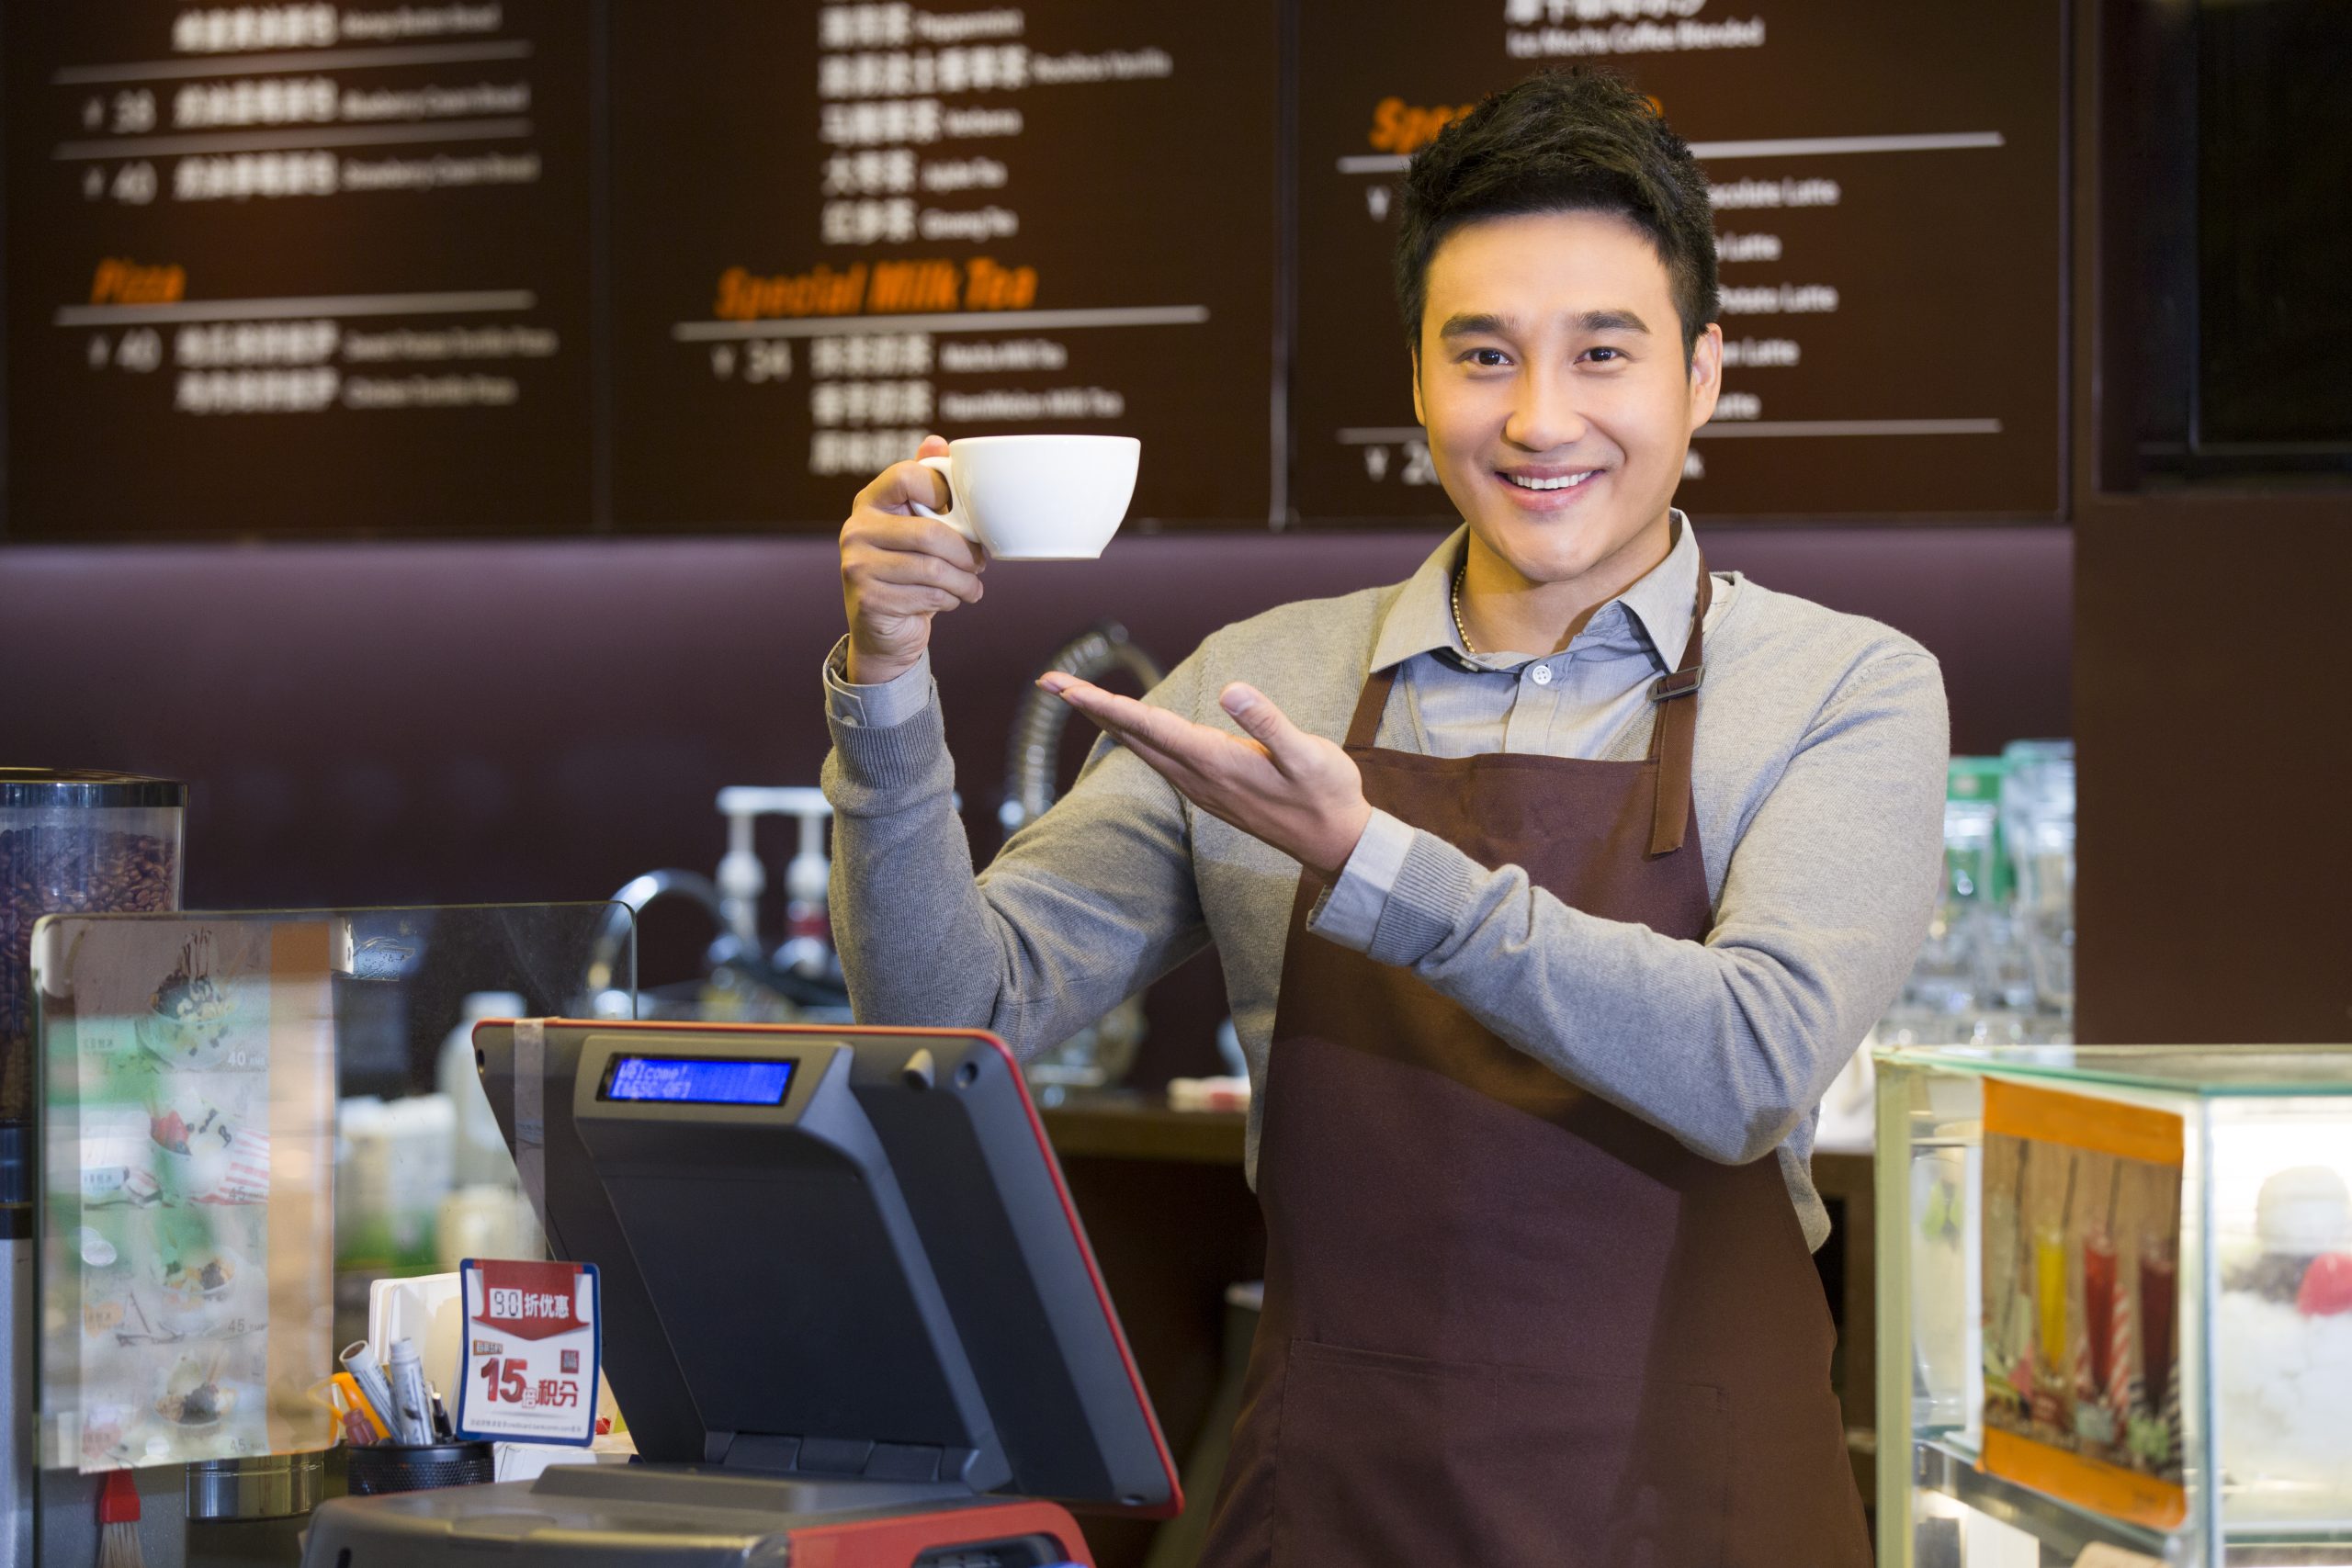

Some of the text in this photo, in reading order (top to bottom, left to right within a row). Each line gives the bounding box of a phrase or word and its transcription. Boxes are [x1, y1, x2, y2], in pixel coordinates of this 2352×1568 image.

[1610, 20, 1674, 53] Coffee
[1676, 14, 1765, 50] Blended
[1781, 175, 1840, 207] Latte
[1724, 231, 1782, 263] Latte
[715, 255, 1039, 324] Special Milk Tea
[1781, 282, 1839, 313] Latte
[1741, 336, 1801, 367] Latte
[227, 1050, 246, 1066] 40
[228, 1318, 245, 1333] 45
